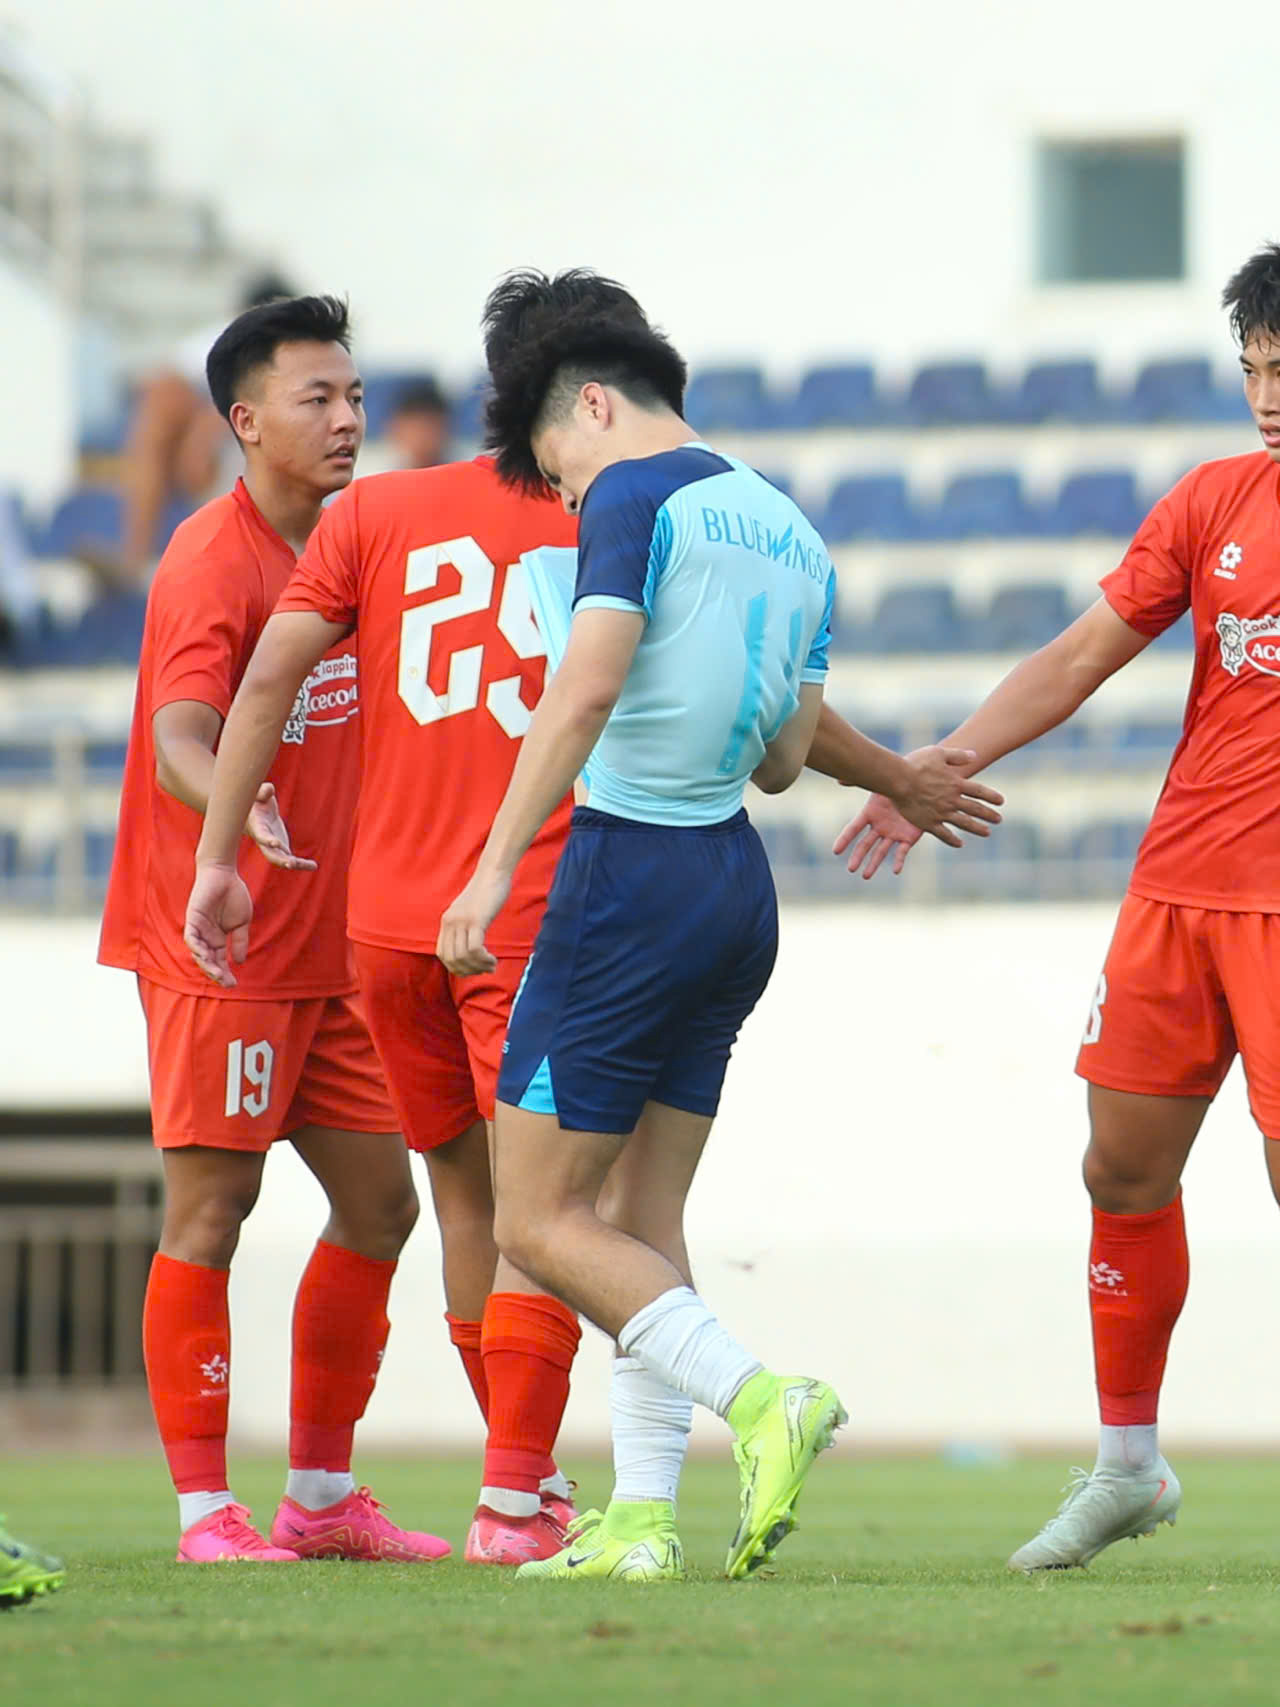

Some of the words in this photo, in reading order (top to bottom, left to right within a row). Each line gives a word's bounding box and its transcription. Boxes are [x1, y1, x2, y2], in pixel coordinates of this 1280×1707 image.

[702, 507, 824, 585] BLUEWINGS
[1242, 618, 1278, 634] Cook
[224, 1038, 274, 1118] 19
